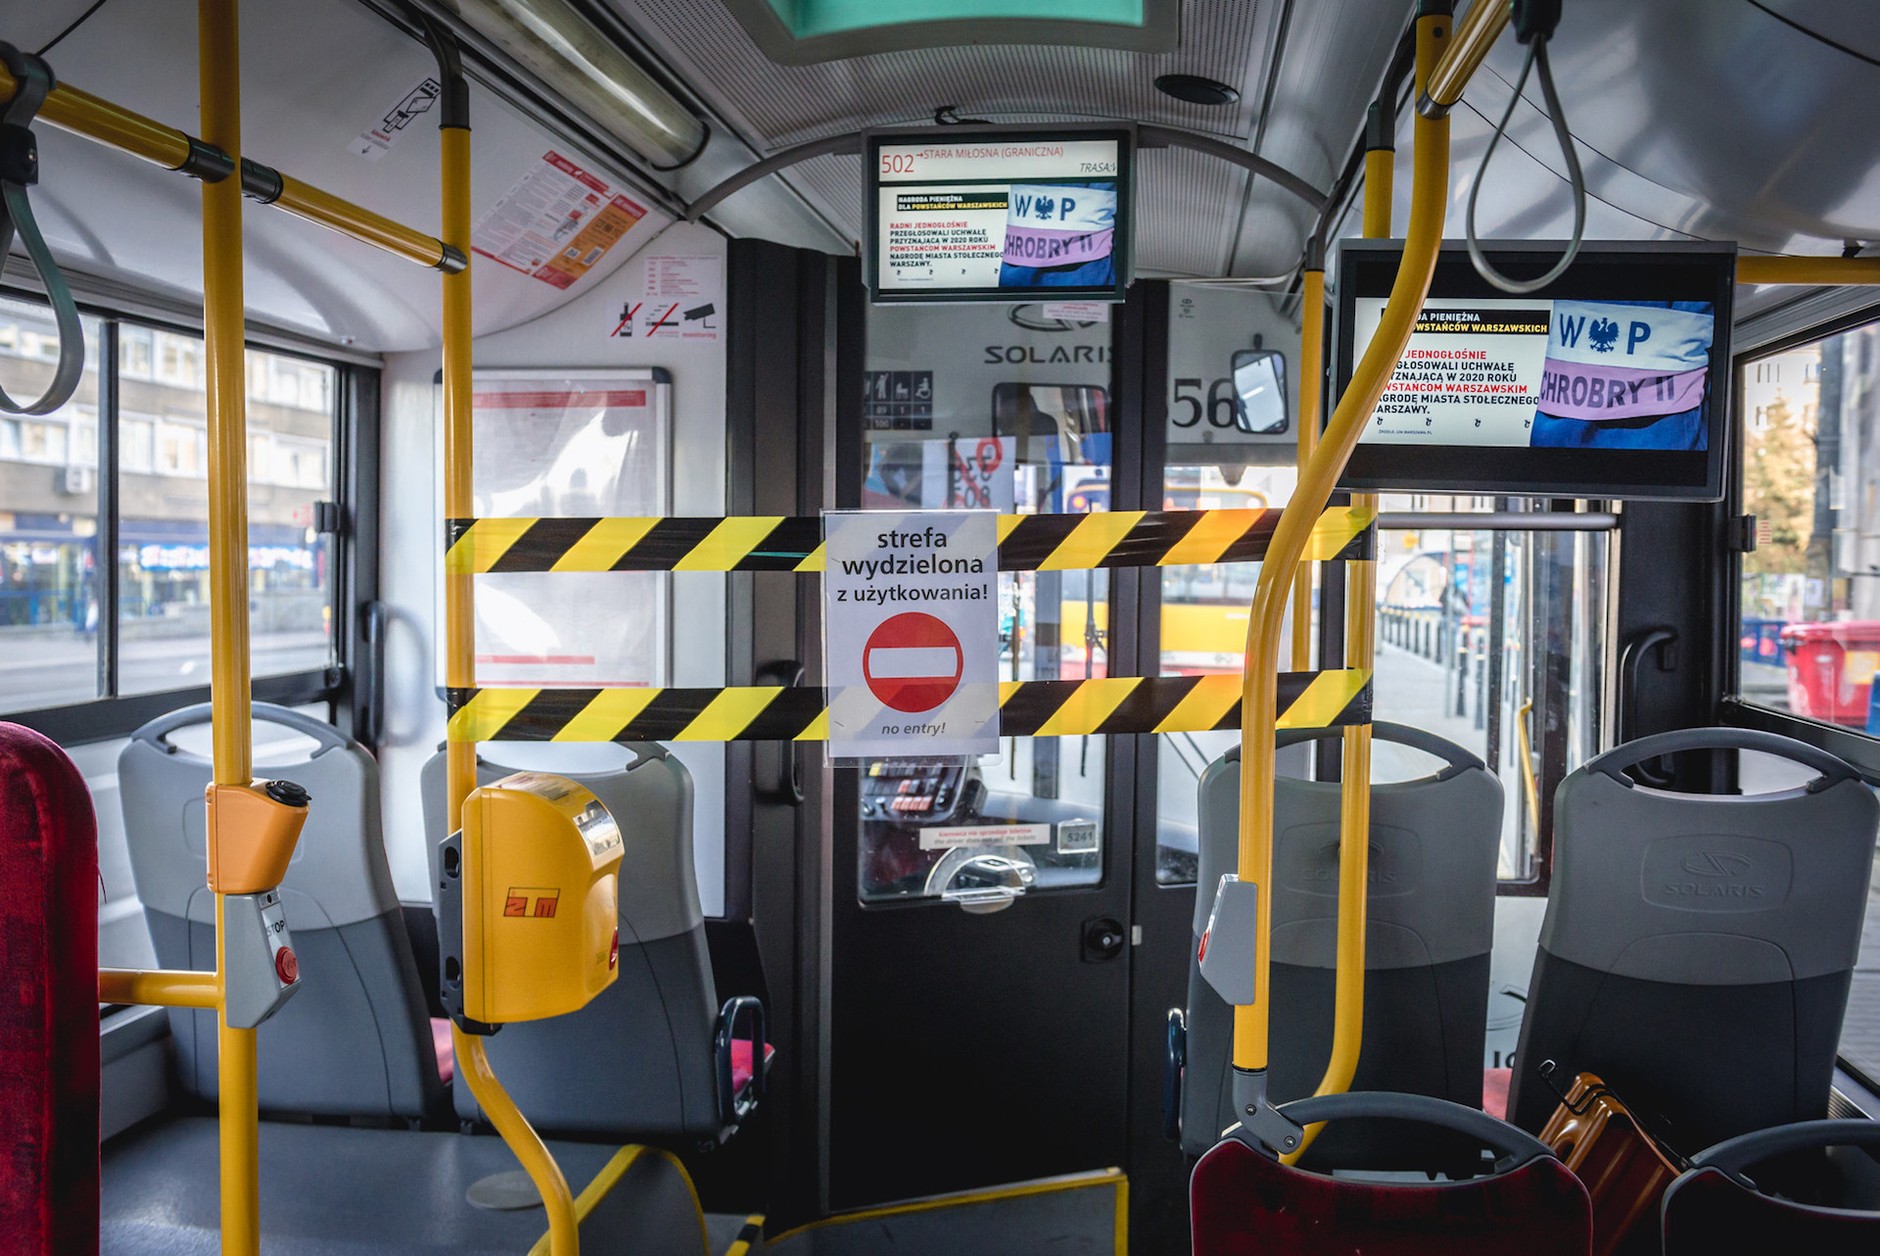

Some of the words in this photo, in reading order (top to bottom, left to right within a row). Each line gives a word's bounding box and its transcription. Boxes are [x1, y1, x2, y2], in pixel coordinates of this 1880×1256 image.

[923, 149, 953, 159] STARA
[955, 148, 999, 158] MIŁOSNA
[1001, 146, 1064, 158] (GRANICZNA)
[882, 154, 914, 173] 502
[929, 194, 963, 203] PIENIĘŻNA
[912, 202, 955, 210] POWSTAŃCÓW
[957, 201, 1008, 209] WARSZAWSKICH
[1060, 197, 1076, 221] P
[914, 221, 968, 229] JEDNOGŁOŚNIE
[951, 228, 986, 236] UCHWAŁĘ
[890, 260, 932, 268] WARSZAWY.
[1430, 311, 1480, 324] PIENIĘŻNA
[1413, 321, 1468, 333] WSTAŃCÓW
[1471, 323, 1547, 333] WARSZAWSKICH
[1627, 321, 1651, 355] P
[1405, 348, 1487, 360] JEDNOGŁOŚNIE
[1396, 361, 1458, 371] GŁOSOWALI
[1461, 362, 1514, 373] UCHWAŁĘ
[1447, 373, 1456, 382] W
[1459, 373, 1484, 382] 2020
[1487, 373, 1517, 383] ROKU
[1386, 381, 1442, 392] WSTAŃCOM
[1446, 384, 1527, 394] WARSZAWSKIM
[1379, 394, 1418, 405] GRODĘ
[1421, 395, 1460, 404] MIASTA
[1463, 395, 1539, 405] STOŁECZNEGO
[1373, 404, 1430, 414] ARSZAWY.
[877, 527, 948, 549] strefa
[842, 553, 984, 580] wydzielona
[837, 589, 847, 601] z
[854, 584, 988, 605] użytkowania!
[881, 724, 899, 735] no
[903, 722, 946, 737] entry!
[1067, 831, 1093, 842] 5241
[1662, 883, 1763, 898] SOLARIS
[266, 920, 285, 938] STOP
